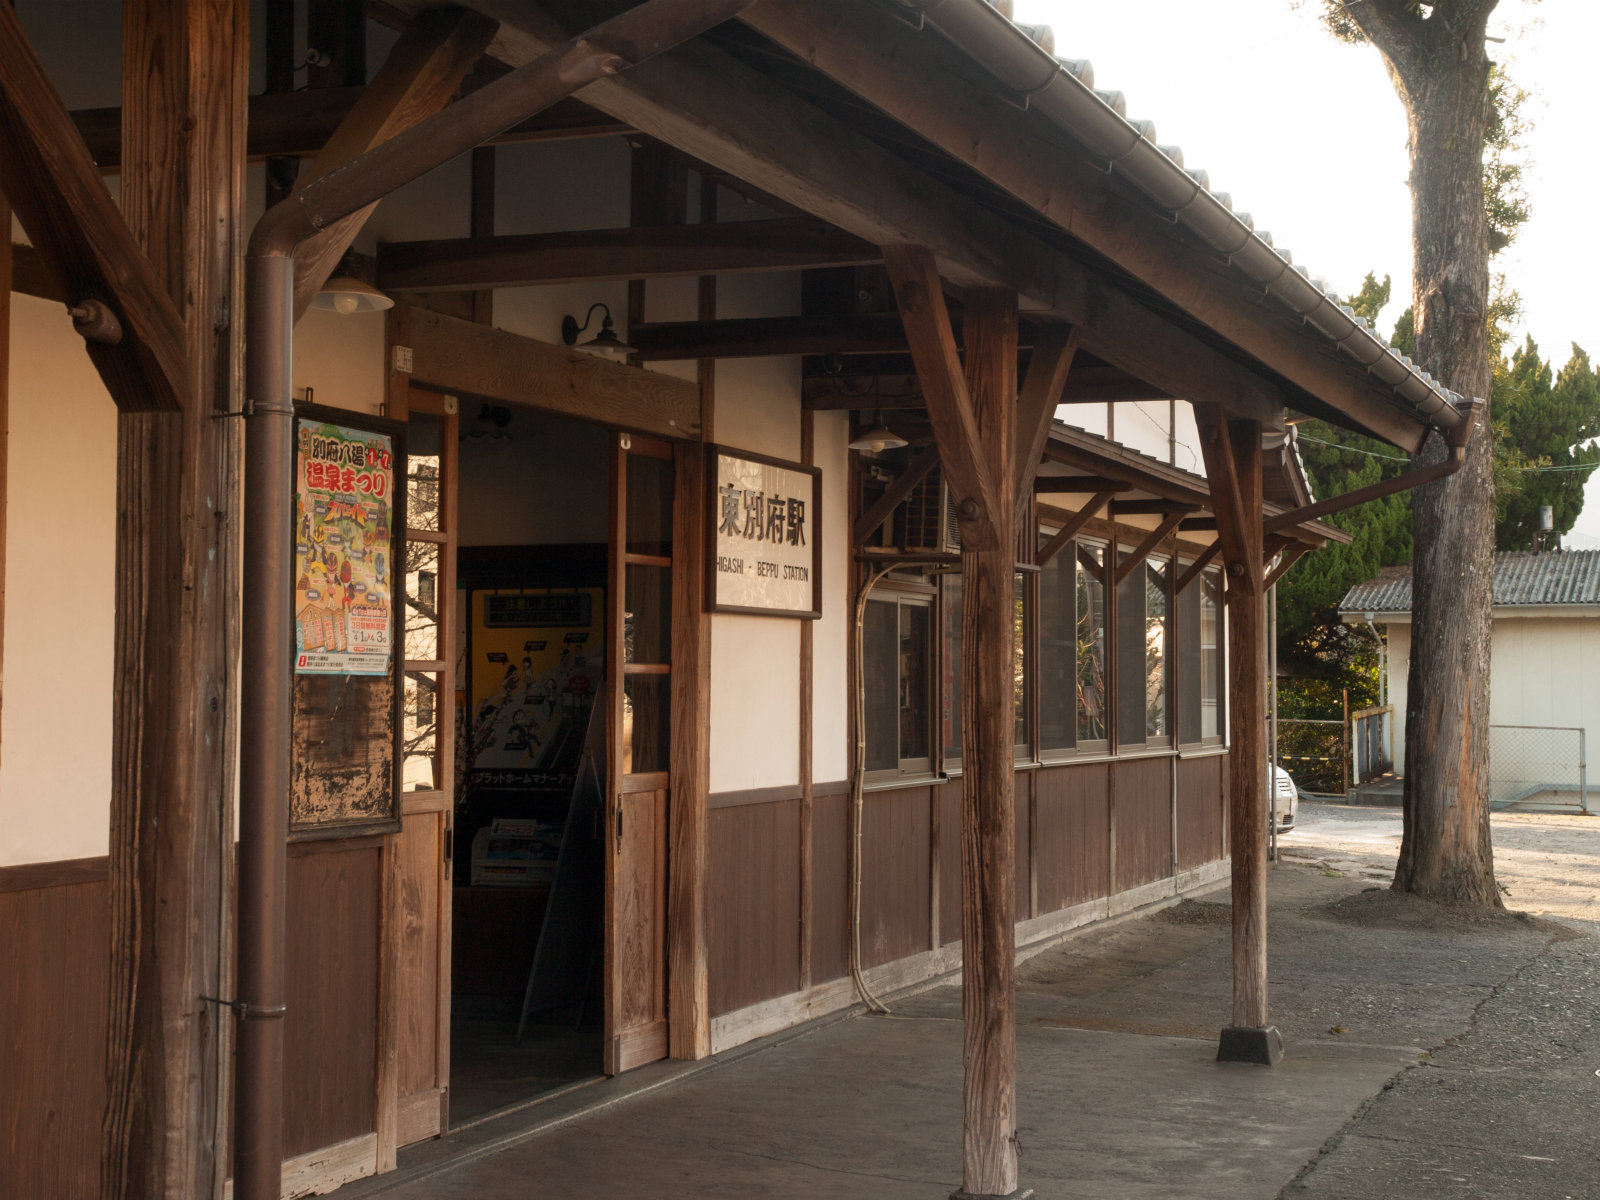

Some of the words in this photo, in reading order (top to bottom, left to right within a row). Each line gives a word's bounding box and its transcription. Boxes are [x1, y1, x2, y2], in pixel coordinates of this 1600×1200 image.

[312, 437, 365, 467] 別府八湯
[306, 462, 386, 497] 温泉まつり
[719, 483, 806, 547] 東別府駅
[716, 556, 744, 575] HIGASHI
[757, 561, 779, 579] BEPPU
[783, 564, 809, 582] STATION
[475, 773, 578, 785] プラットホームマナーアッ
